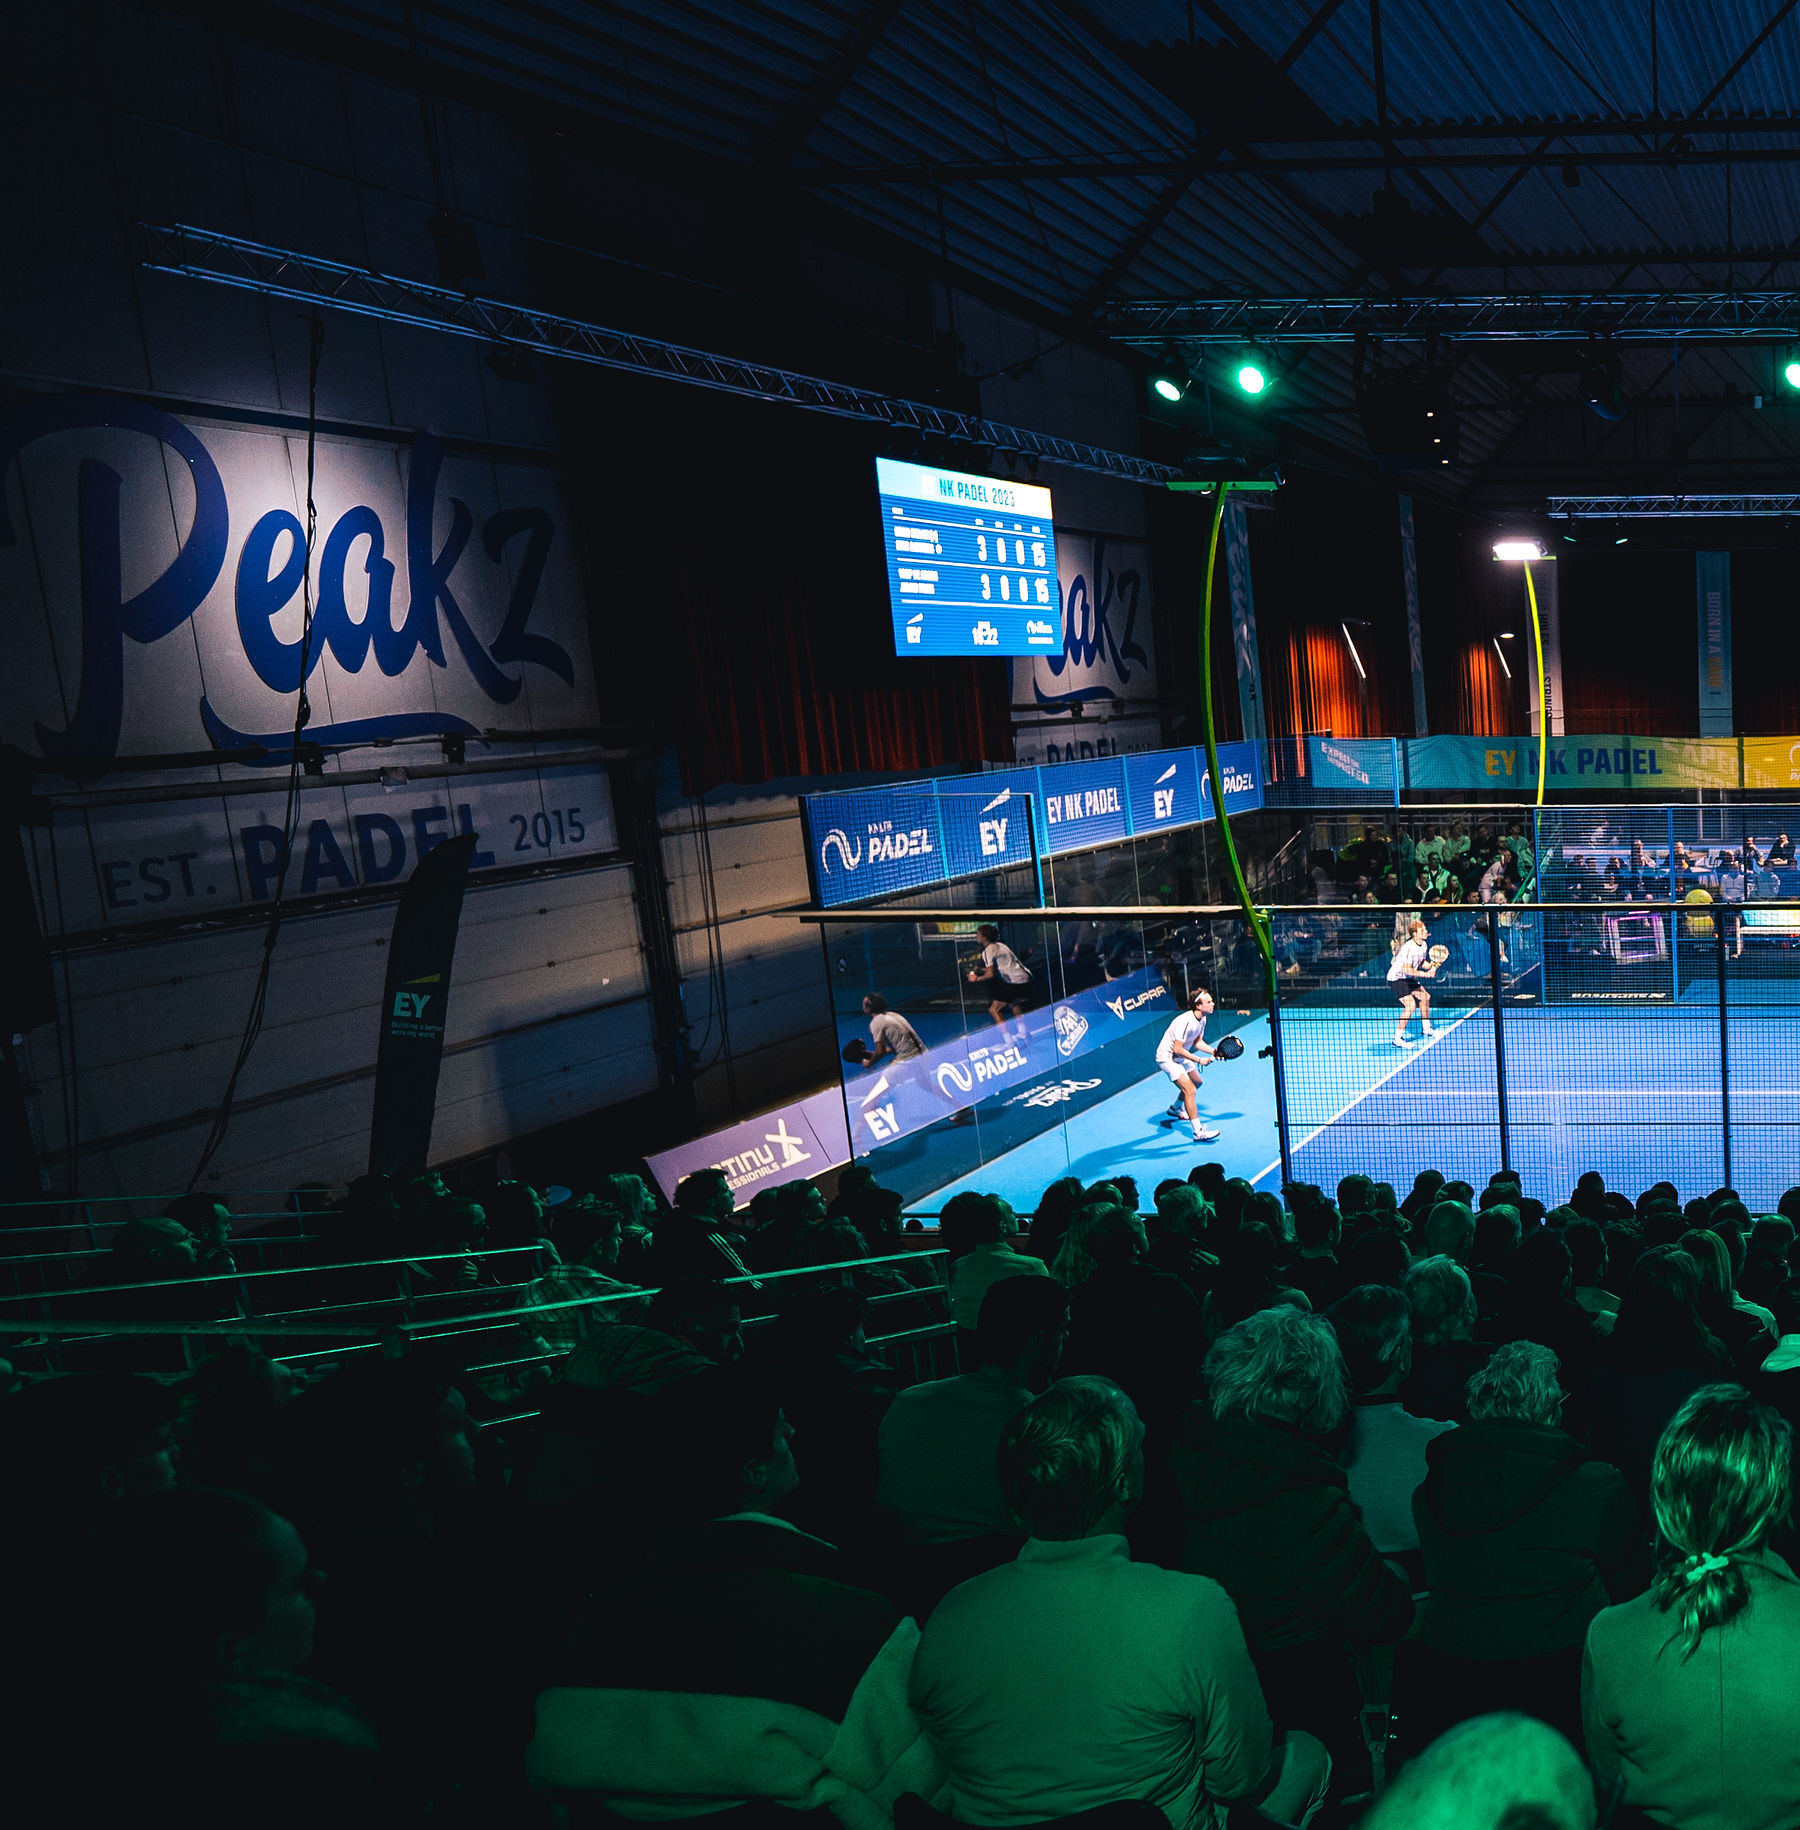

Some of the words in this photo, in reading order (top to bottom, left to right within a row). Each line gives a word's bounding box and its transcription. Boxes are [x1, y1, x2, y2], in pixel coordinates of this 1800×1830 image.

[939, 478, 954, 497] NK
[958, 482, 988, 502] PADEL
[992, 487, 1015, 507] 2023
[0, 393, 575, 758] Peakz
[1485, 750, 1517, 775] EY
[1528, 749, 1567, 775] NK
[1577, 748, 1662, 774] PADEL
[1223, 773, 1254, 794] PADEL
[1047, 796, 1062, 823] EY
[1065, 792, 1083, 820] NK
[1085, 787, 1120, 817] PADEL
[1154, 788, 1174, 818] EY
[868, 829, 932, 863] PADEL
[979, 818, 1008, 856] EY
[102, 852, 217, 909] EST.
[240, 803, 495, 902] PADEL
[508, 807, 586, 852] 2015
[393, 991, 431, 1018] EY
[1124, 985, 1166, 1011] CUPRA
[974, 1046, 1028, 1083] PADEL
[864, 1103, 900, 1141] EY
[727, 1162, 780, 1190] ESSIONALS
